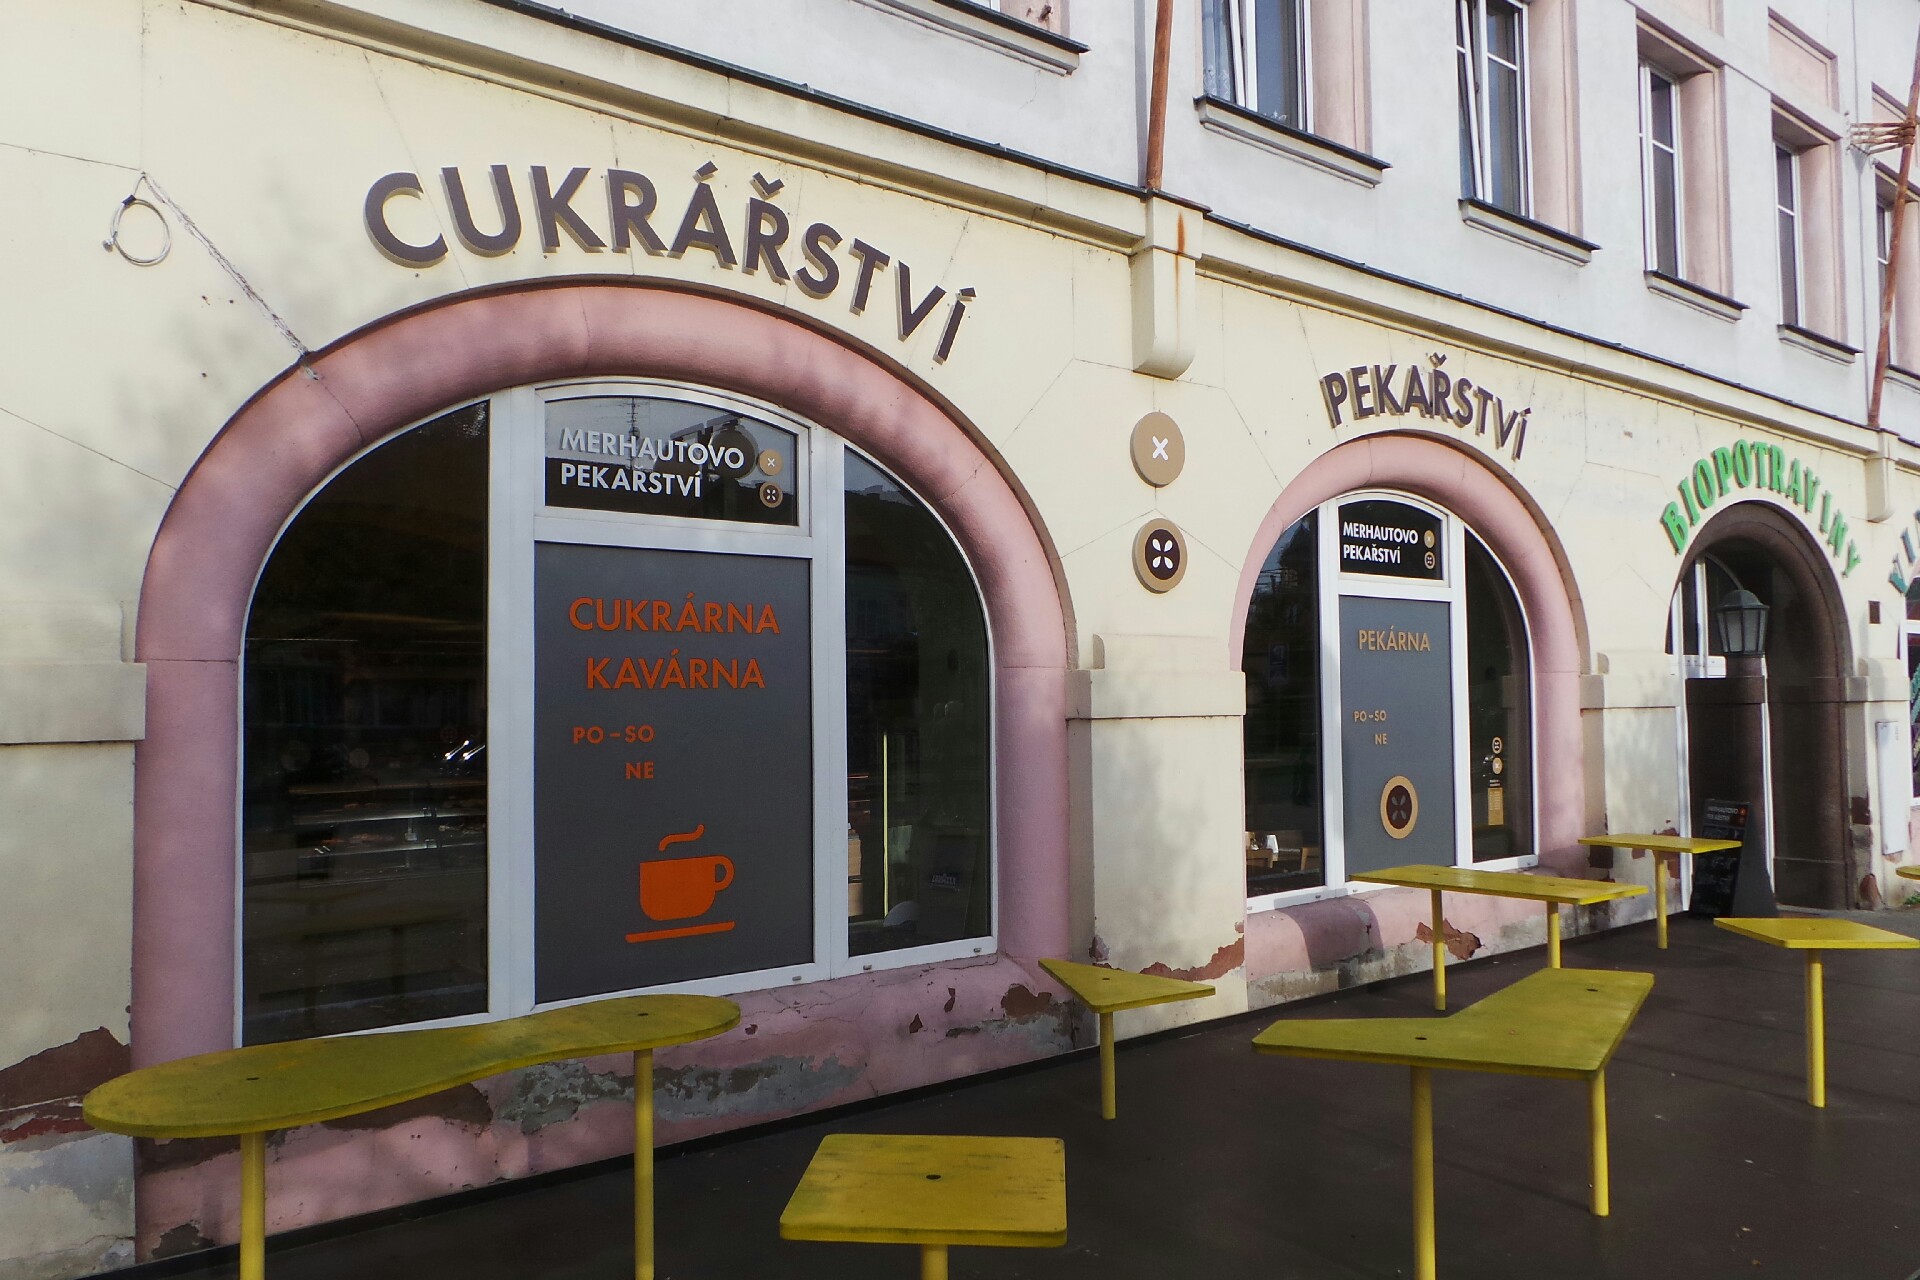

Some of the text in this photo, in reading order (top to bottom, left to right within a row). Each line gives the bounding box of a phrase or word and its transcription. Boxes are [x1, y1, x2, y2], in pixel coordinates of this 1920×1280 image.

[363, 160, 977, 365] CUKRÁŘSTVÍ
[1319, 352, 1532, 462] PEKAŘSTVÍ
[561, 427, 745, 469] MERHAUTOVO
[561, 462, 701, 498] PEKAŘSTVÍ
[1660, 439, 1862, 579] BIOPOTRAVINY
[1343, 521, 1419, 545] MERHAUTOVO
[1343, 543, 1401, 564] PEKAŘSTVÍ
[569, 592, 781, 634] CUKRÁRNA
[1358, 625, 1431, 652] PEKÁRNA
[587, 648, 766, 689] KAVÁRNA
[1374, 733, 1388, 745] NE
[625, 761, 655, 780] NE
